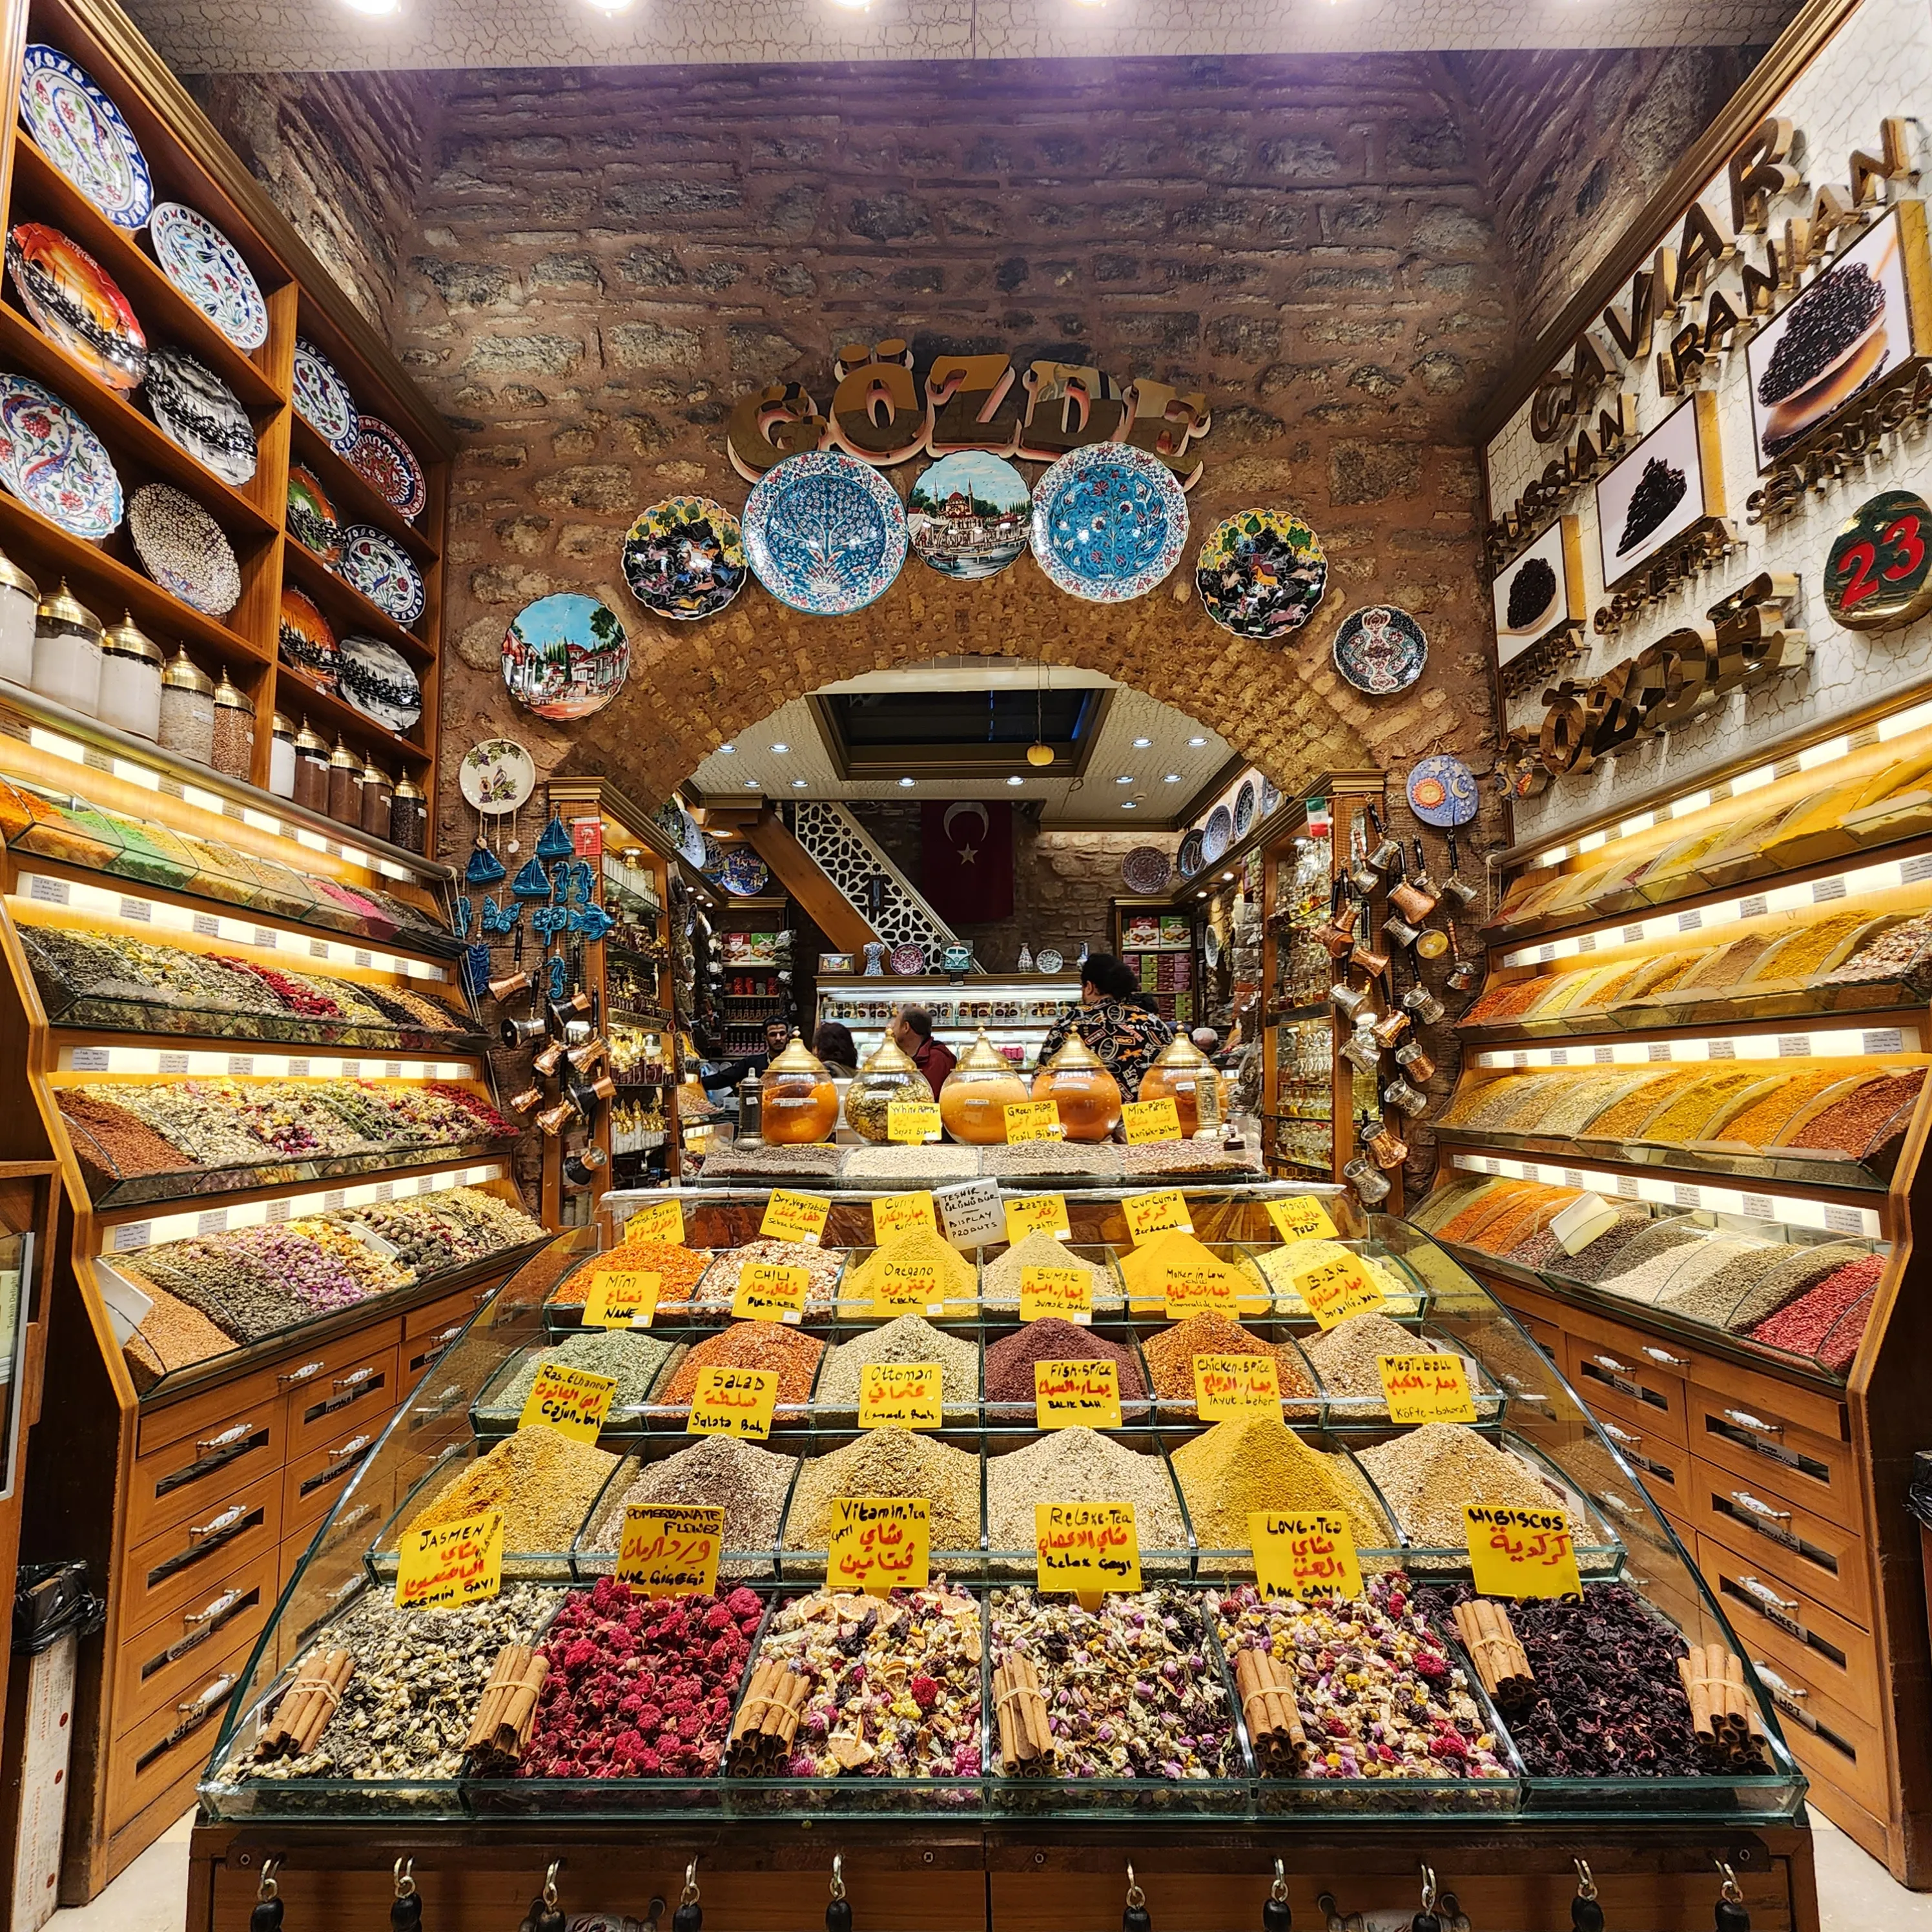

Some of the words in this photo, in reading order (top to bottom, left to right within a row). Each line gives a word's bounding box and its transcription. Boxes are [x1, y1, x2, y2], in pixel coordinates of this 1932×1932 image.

[1657, 116, 1909, 397] IRANIAN
[1530, 117, 1802, 443] CAVIAR
[726, 339, 1211, 486] GÖZDE
[1486, 392, 1638, 562] RUSSIAN
[1836, 514, 1926, 611] 23
[1503, 628, 1585, 699] BELUGA
[9, 1276, 18, 1302] Delight
[7, 1303, 15, 1329] Turkish
[603, 1305, 639, 1320] NANE
[871, 1366, 932, 1381] Ottoman
[626, 1508, 722, 1521] POMEGRANATE
[1468, 1508, 1563, 1531] HIBISCUS
[420, 1523, 484, 1552] JASMEN
[859, 1523, 903, 1552] شاي
[1767, 1607, 1800, 1636] SWEET
[1780, 1697, 1802, 1716] HOT
